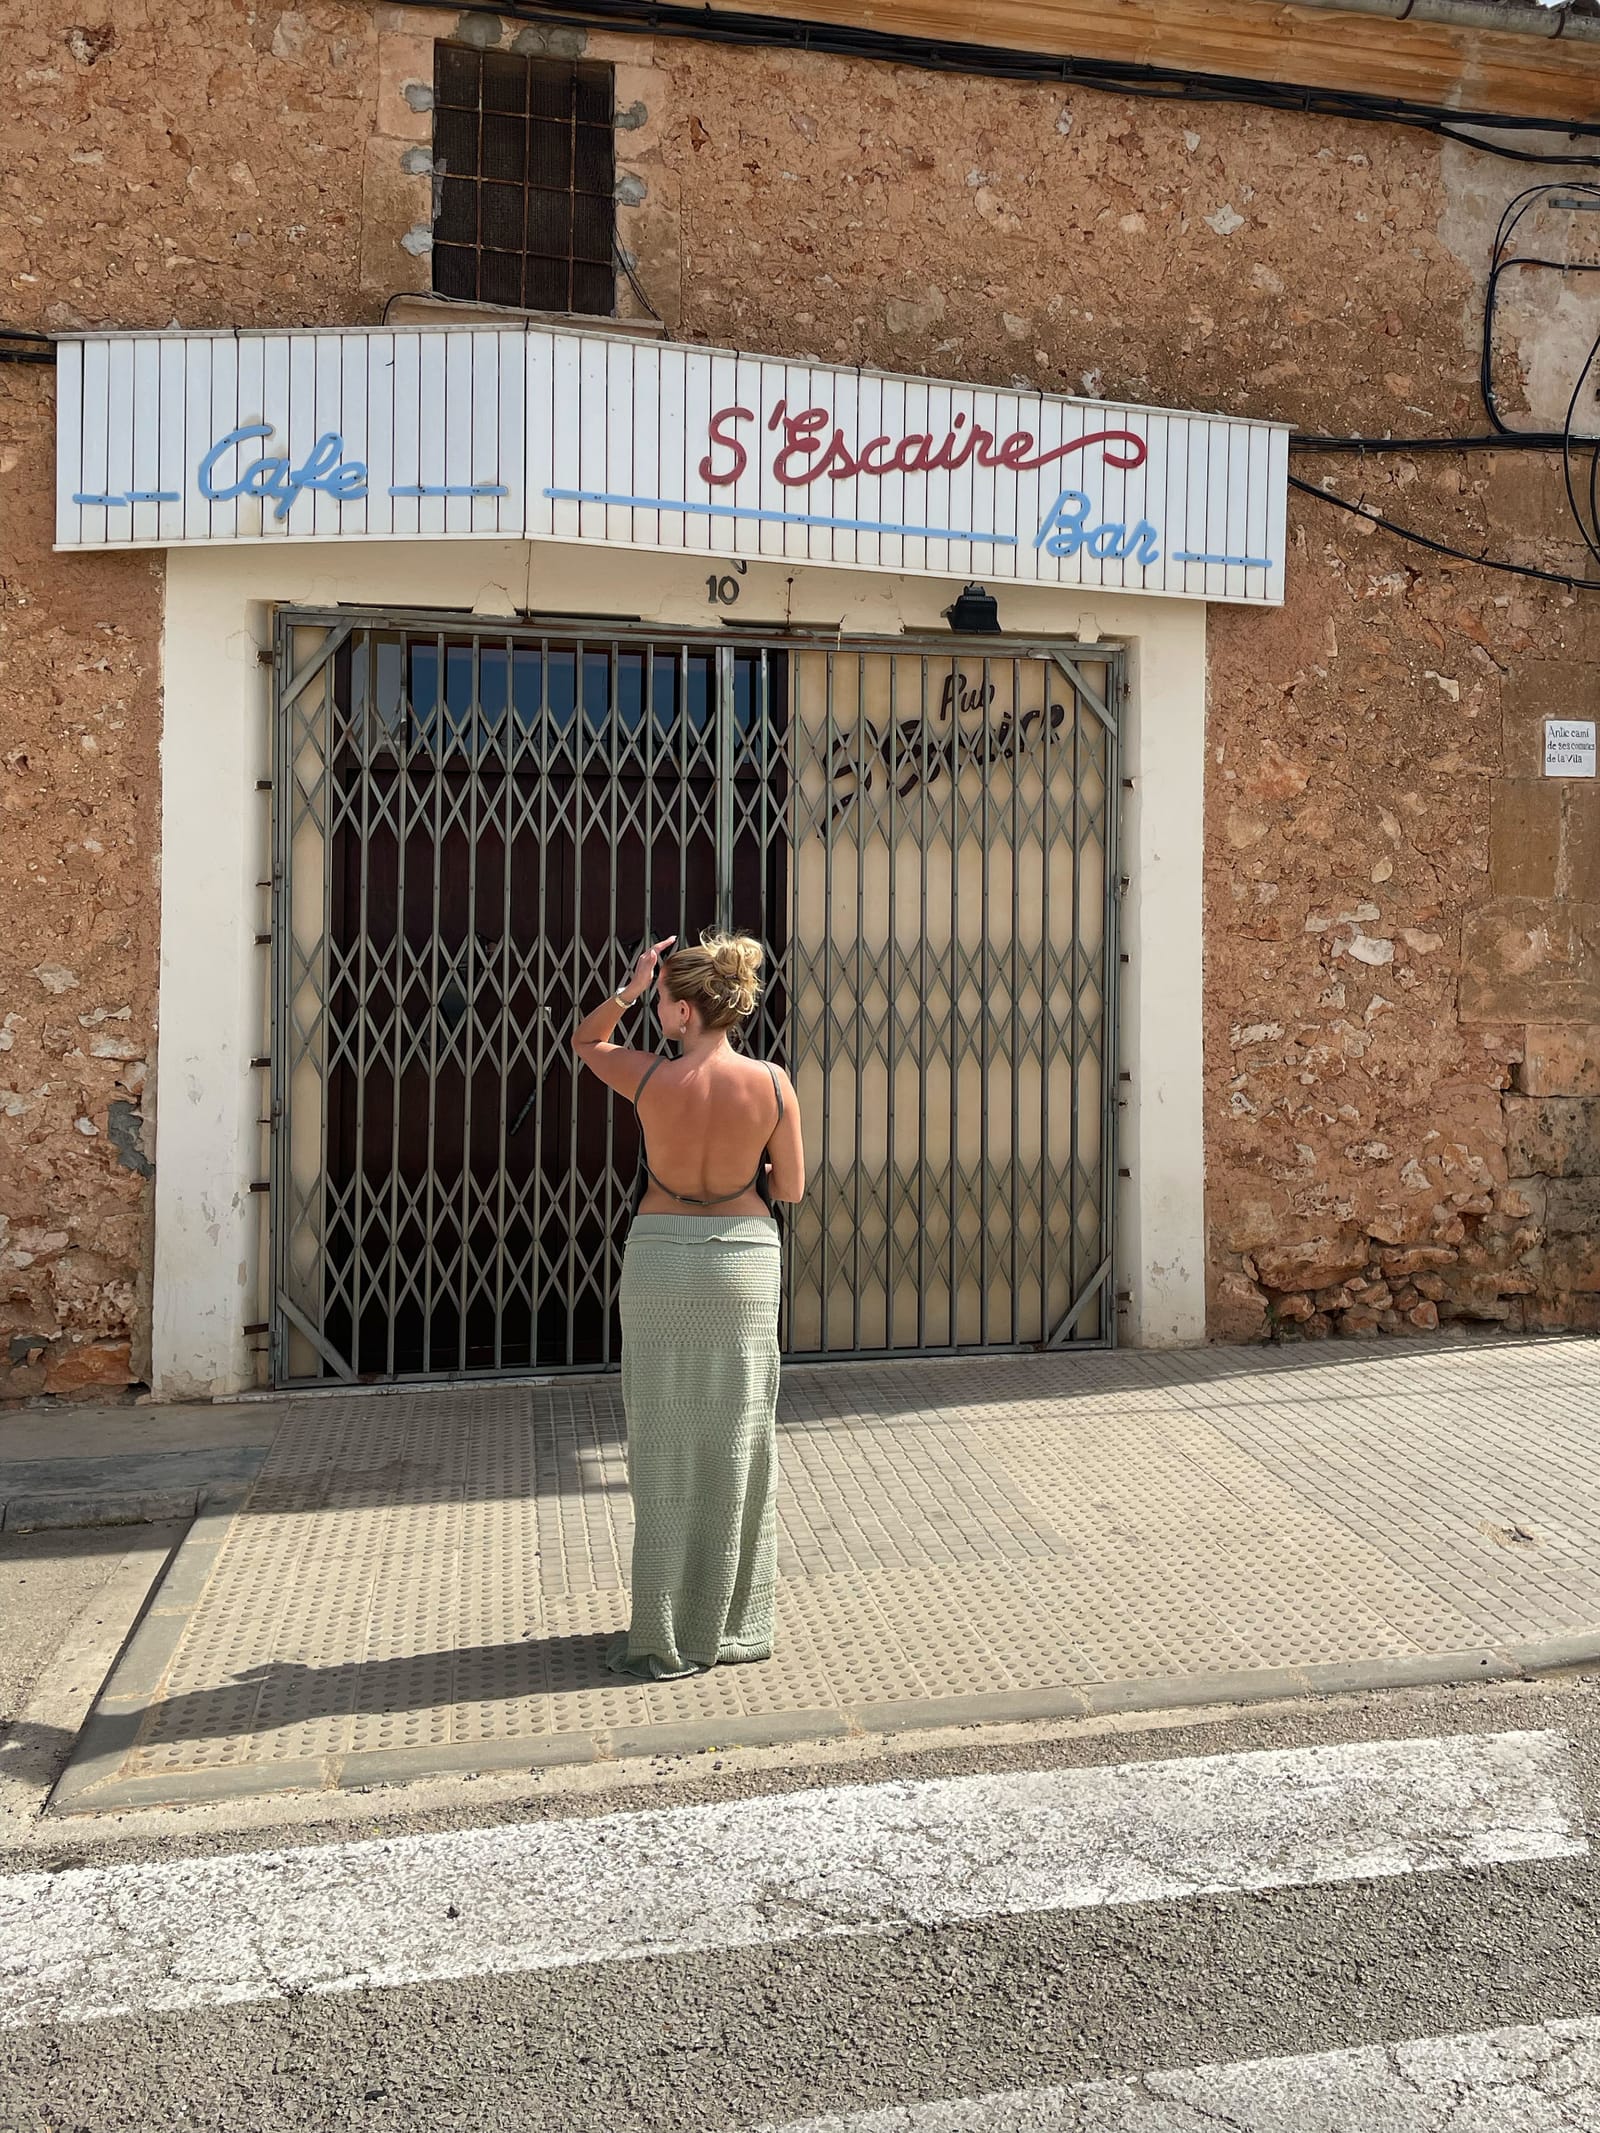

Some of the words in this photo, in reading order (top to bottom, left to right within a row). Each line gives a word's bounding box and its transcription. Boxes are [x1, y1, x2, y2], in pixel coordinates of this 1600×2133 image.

[699, 400, 1147, 486] S'Escaire
[198, 424, 369, 520] Cafe
[1033, 490, 1160, 566] Bar
[705, 575, 740, 606] 10
[939, 673, 996, 721] Pub
[1546, 753, 1557, 763] de
[1557, 753, 1566, 763] la
[1547, 741, 1557, 750] de
